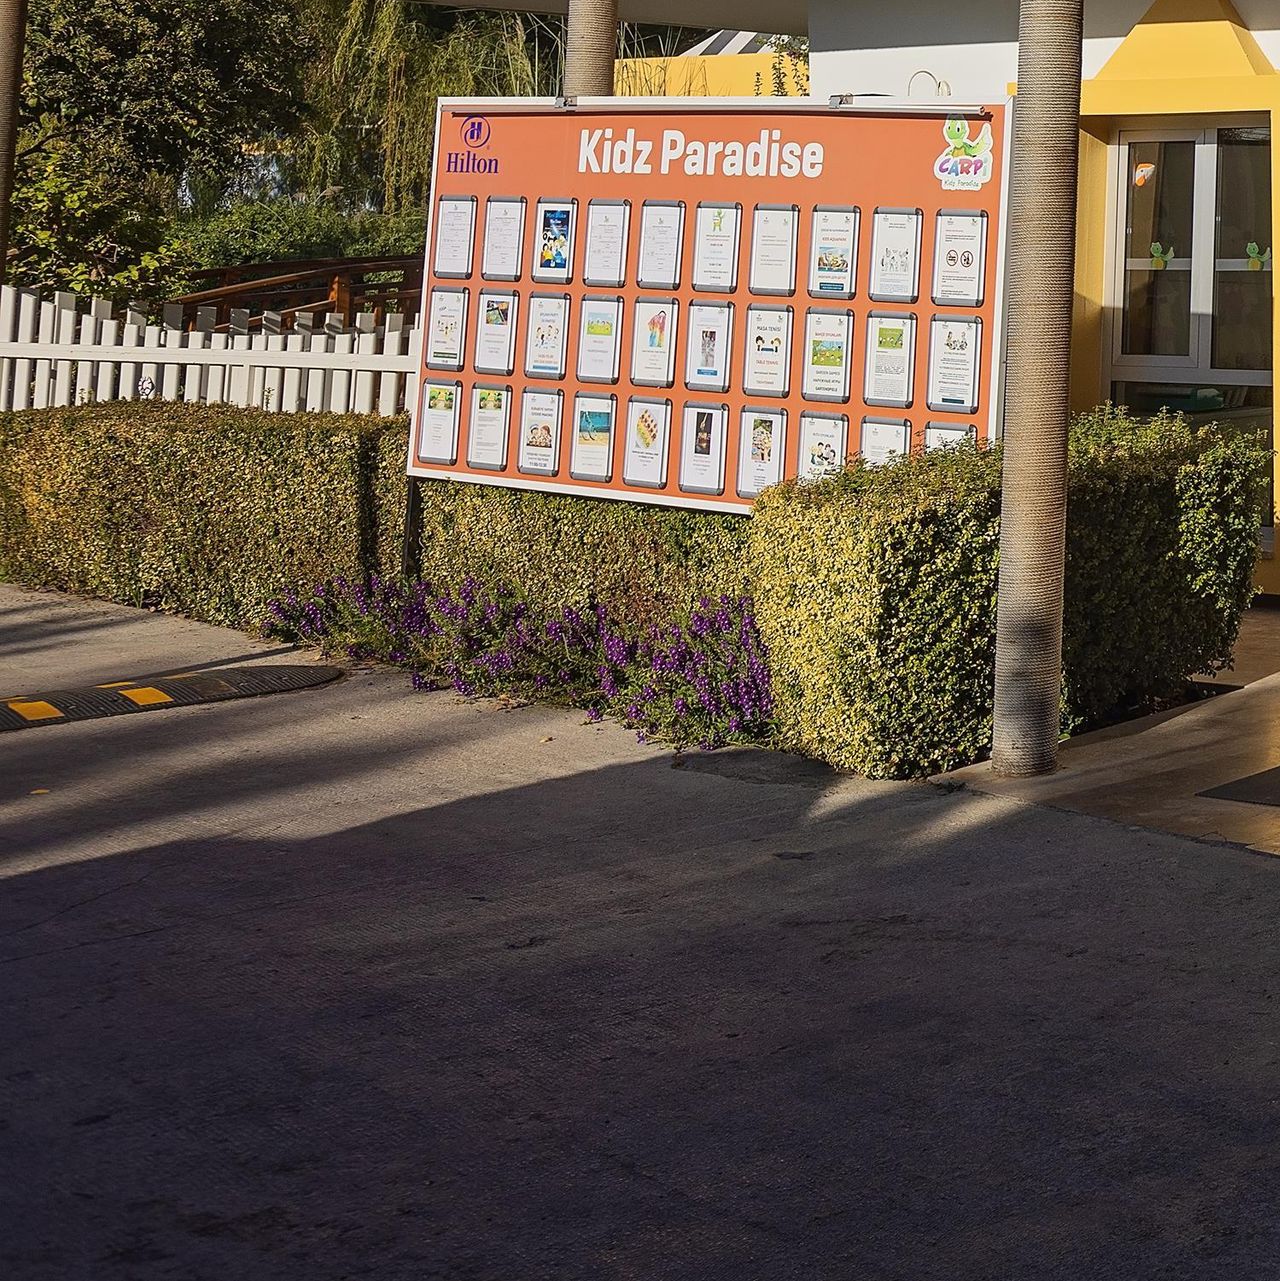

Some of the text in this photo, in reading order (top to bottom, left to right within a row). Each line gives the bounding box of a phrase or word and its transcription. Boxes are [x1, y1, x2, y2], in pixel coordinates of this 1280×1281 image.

[446, 150, 499, 174] Hilton
[578, 127, 825, 179] Kidz Paradise
